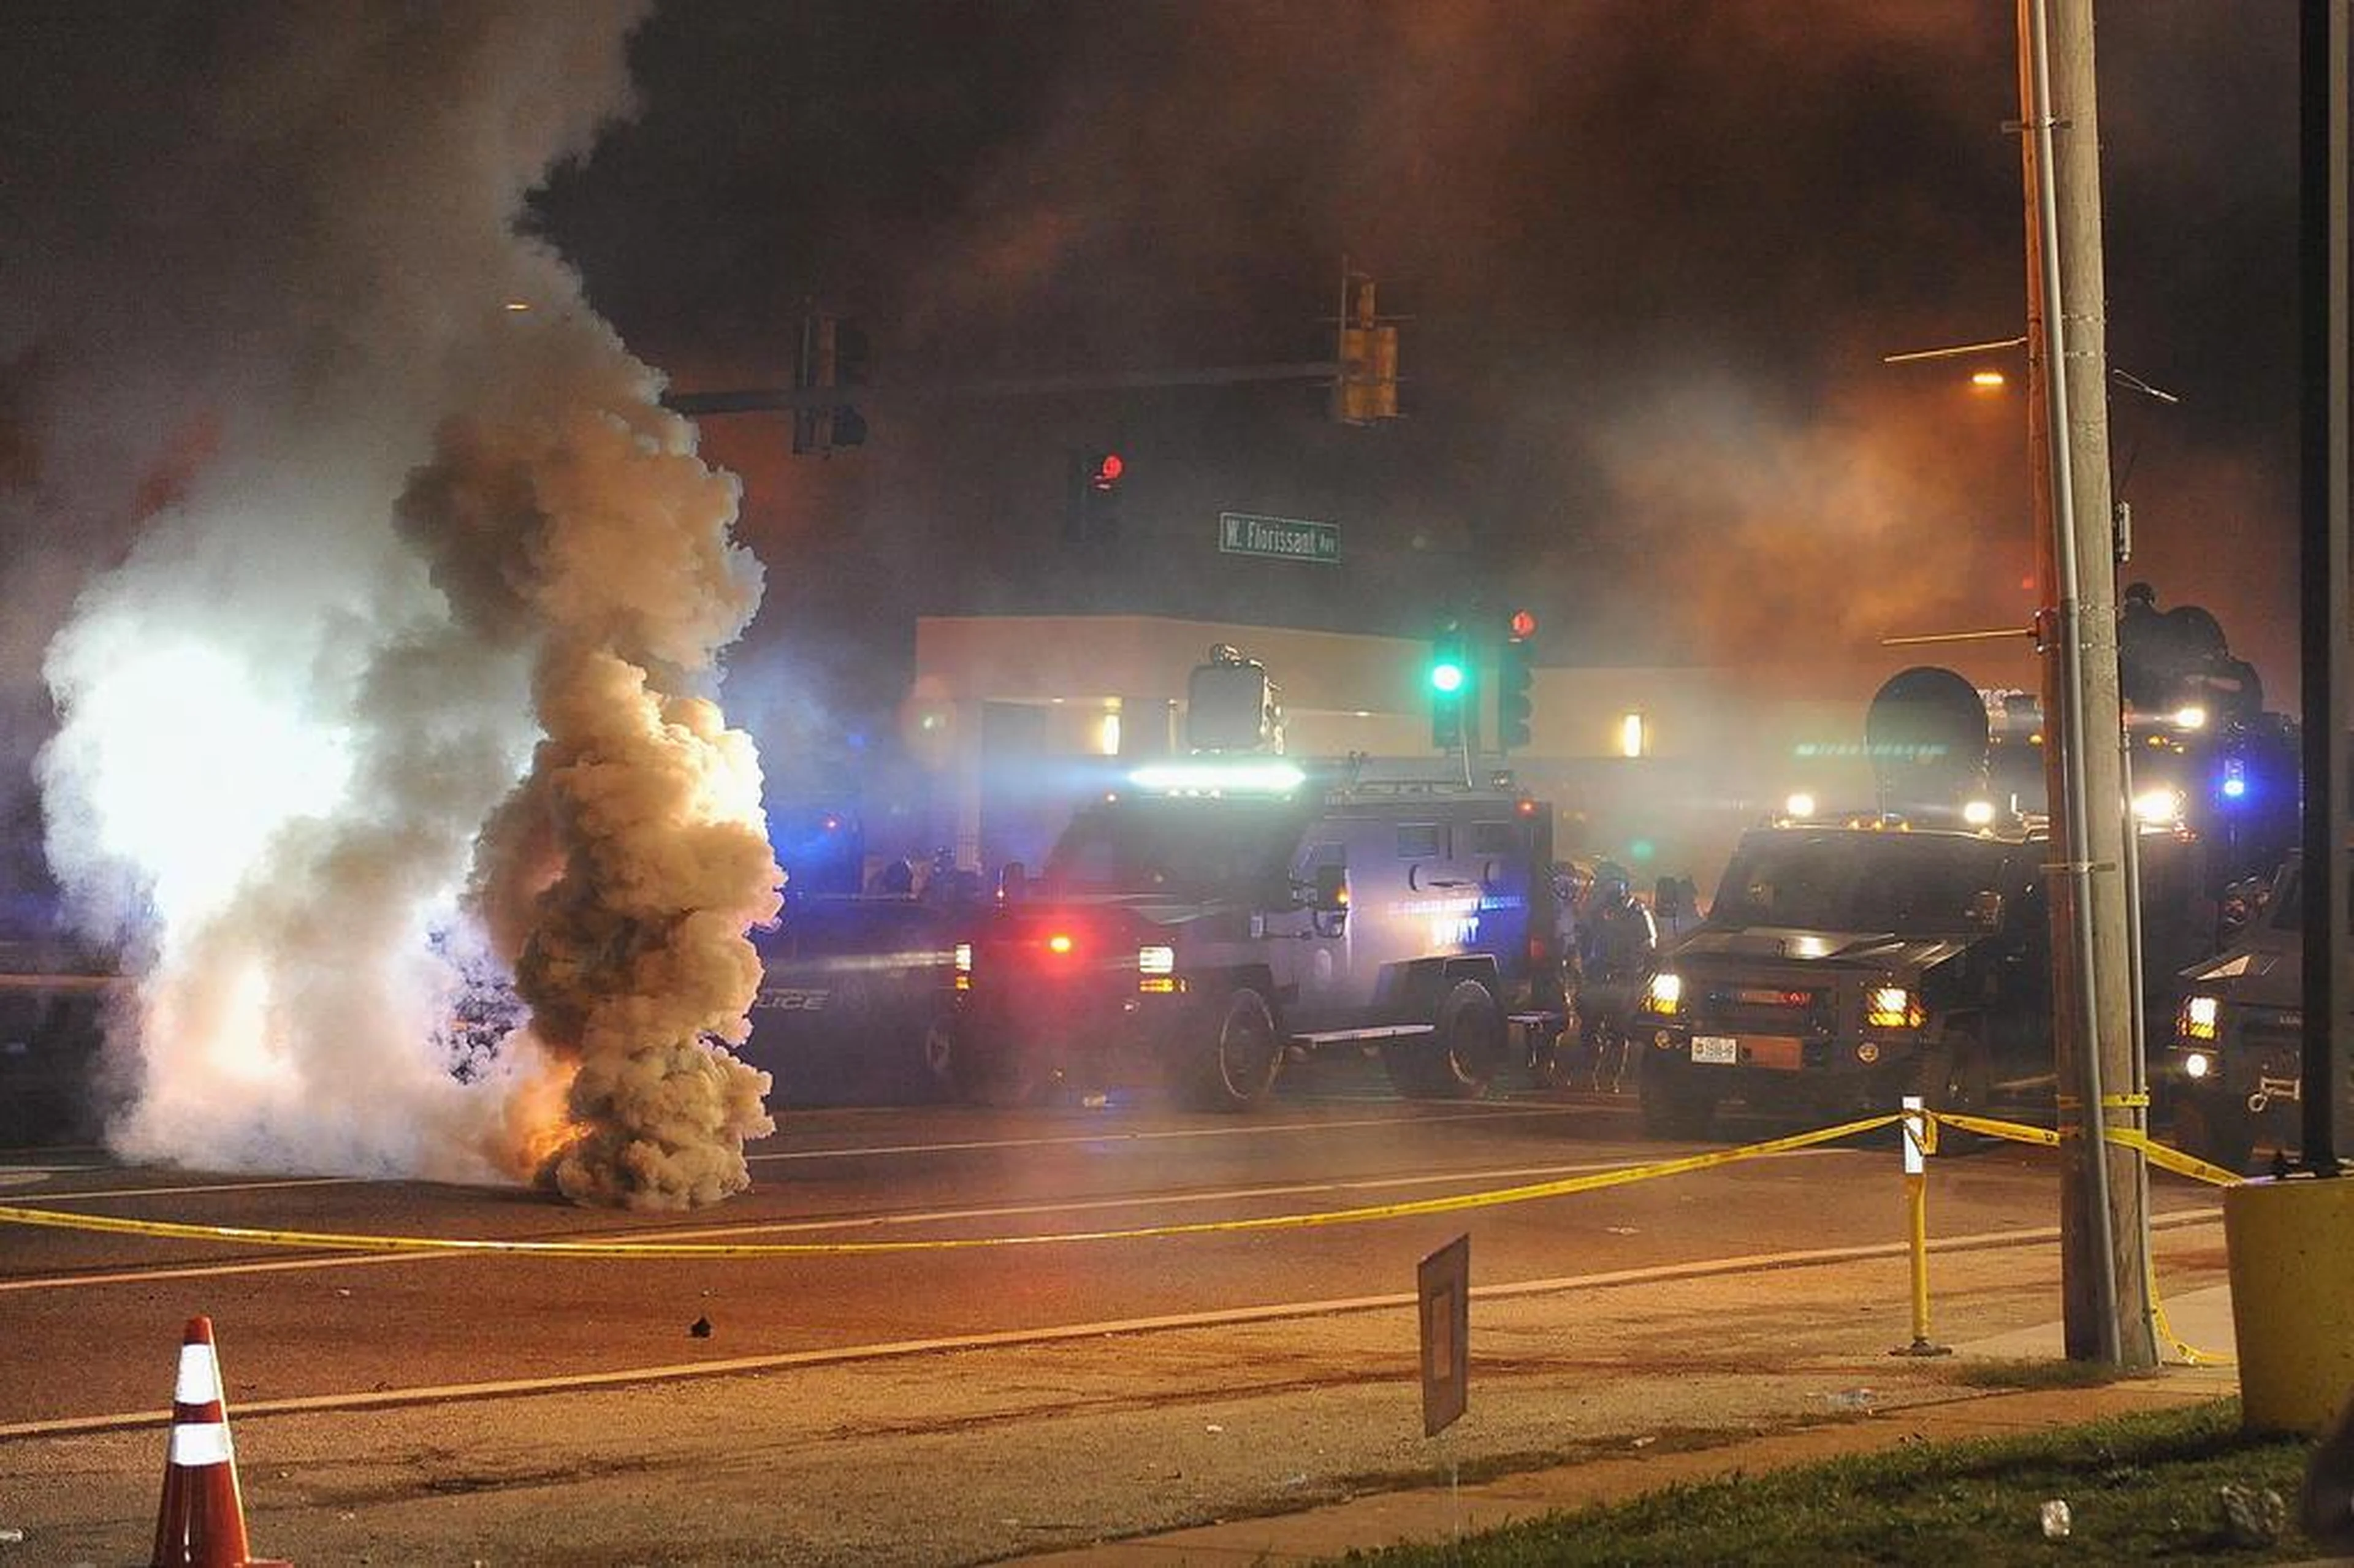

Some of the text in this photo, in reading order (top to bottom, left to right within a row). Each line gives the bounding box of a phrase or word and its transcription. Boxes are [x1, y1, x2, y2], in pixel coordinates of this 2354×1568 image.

[1227, 519, 1242, 547] W.
[1247, 520, 1316, 554] Florissant
[755, 996, 828, 1011] LICE
